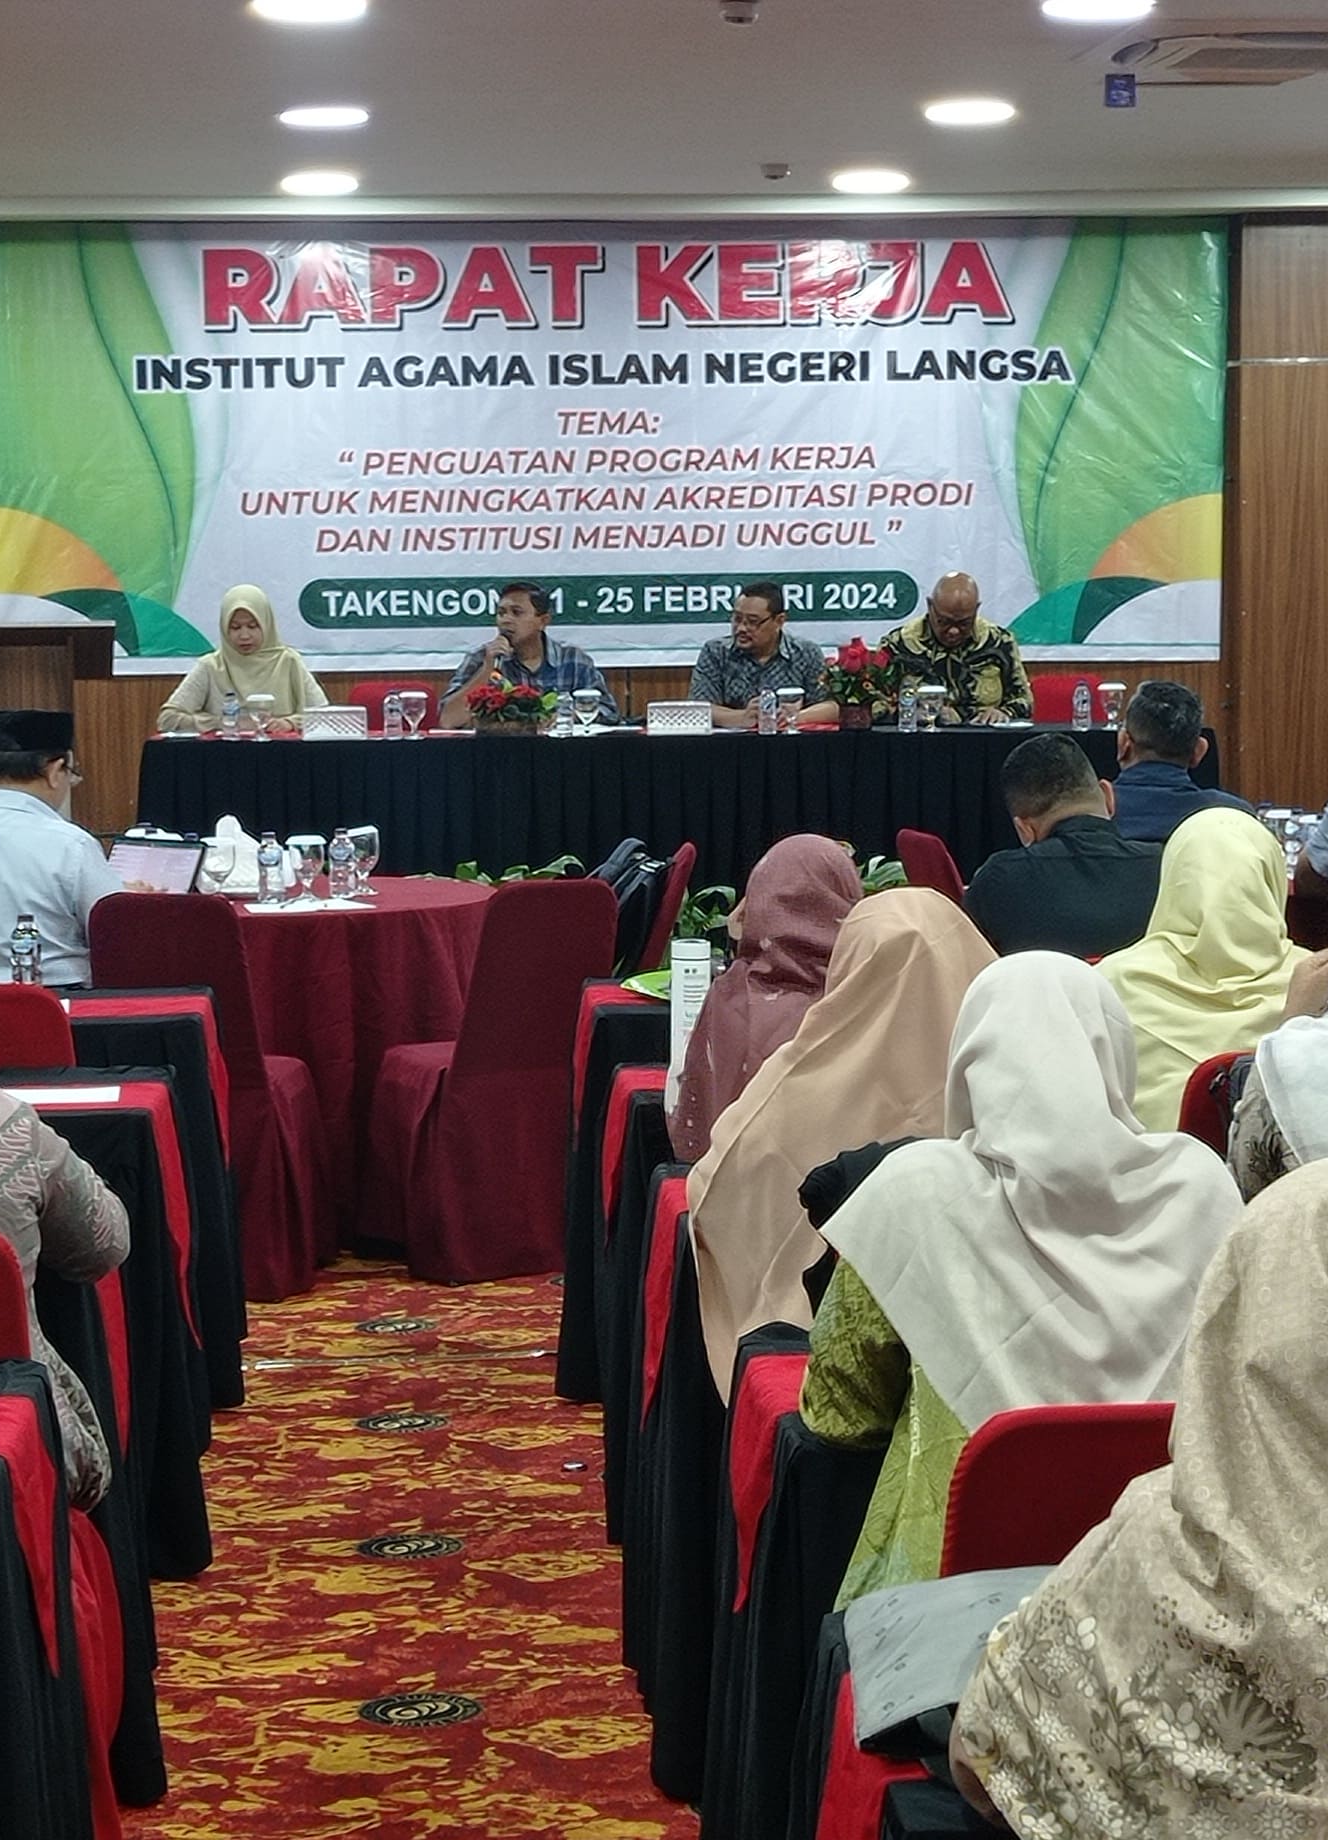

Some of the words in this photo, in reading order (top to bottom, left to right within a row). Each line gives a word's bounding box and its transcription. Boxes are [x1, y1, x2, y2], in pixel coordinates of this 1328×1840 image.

[202, 244, 605, 332] RAPAT
[635, 240, 1015, 328] KERJA
[135, 356, 346, 391] INSTITUT
[357, 354, 535, 388] AGAMA
[548, 352, 688, 387] ISLAM
[705, 350, 870, 384] NEGERI
[888, 348, 1072, 382] LANGSA
[557, 410, 660, 436] TEMA:
[363, 450, 575, 477] PENGUATAN
[585, 447, 760, 473] PROGRAM
[770, 446, 877, 470] KERJA
[240, 491, 360, 516] UNTUK
[368, 487, 646, 514] MENINGKATKAN
[653, 484, 859, 511] AKREDITASI
[867, 483, 974, 507] PRODI
[316, 528, 392, 553] DAN
[401, 526, 562, 552] INSTITUSI
[571, 524, 726, 550] MENJADI
[736, 522, 876, 546] UNGGUL
[596, 587, 634, 613] 25
[823, 583, 898, 609] 2024
